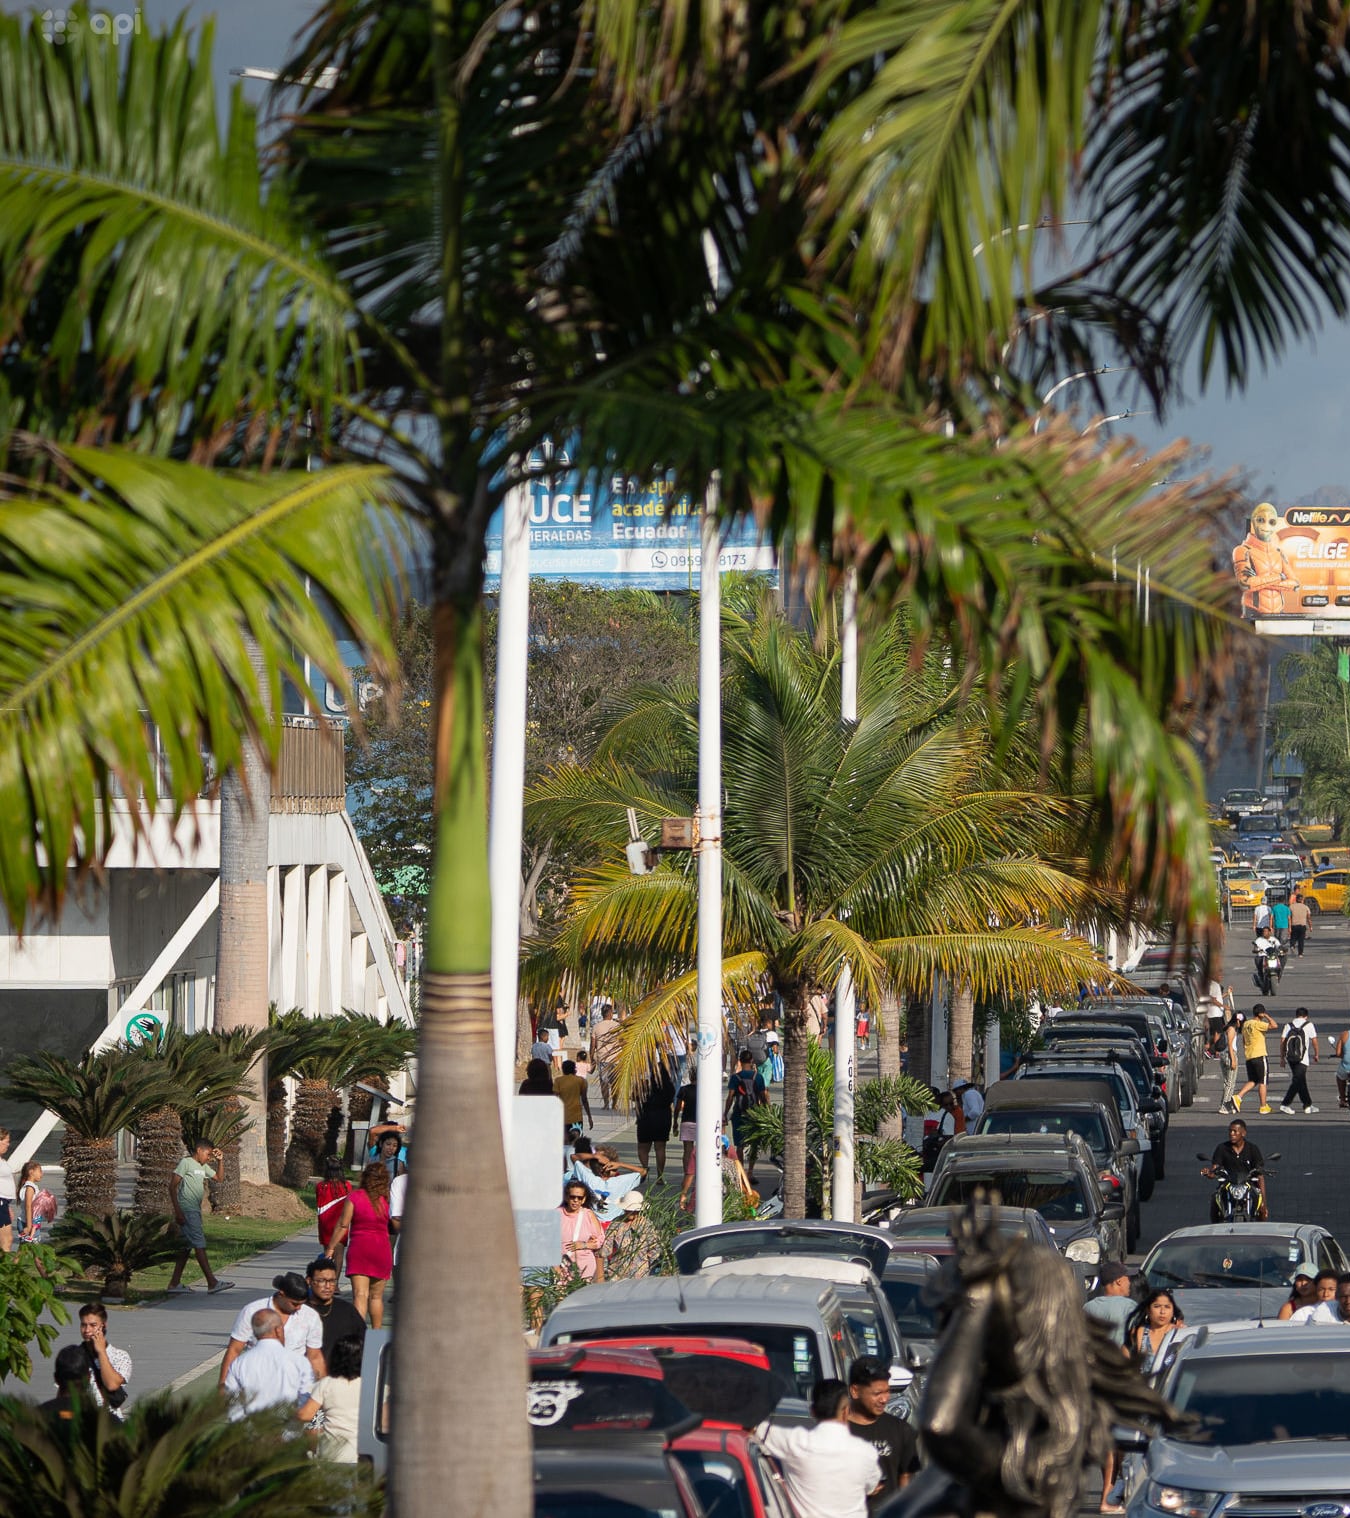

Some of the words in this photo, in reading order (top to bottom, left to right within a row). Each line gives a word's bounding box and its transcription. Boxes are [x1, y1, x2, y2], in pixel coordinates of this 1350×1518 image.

[530, 494, 592, 523] UCE
[530, 530, 592, 542] ERALDAS
[612, 522, 687, 539] Ecuador
[1296, 542, 1348, 559] ELIGE
[671, 554, 746, 567] 09598173
